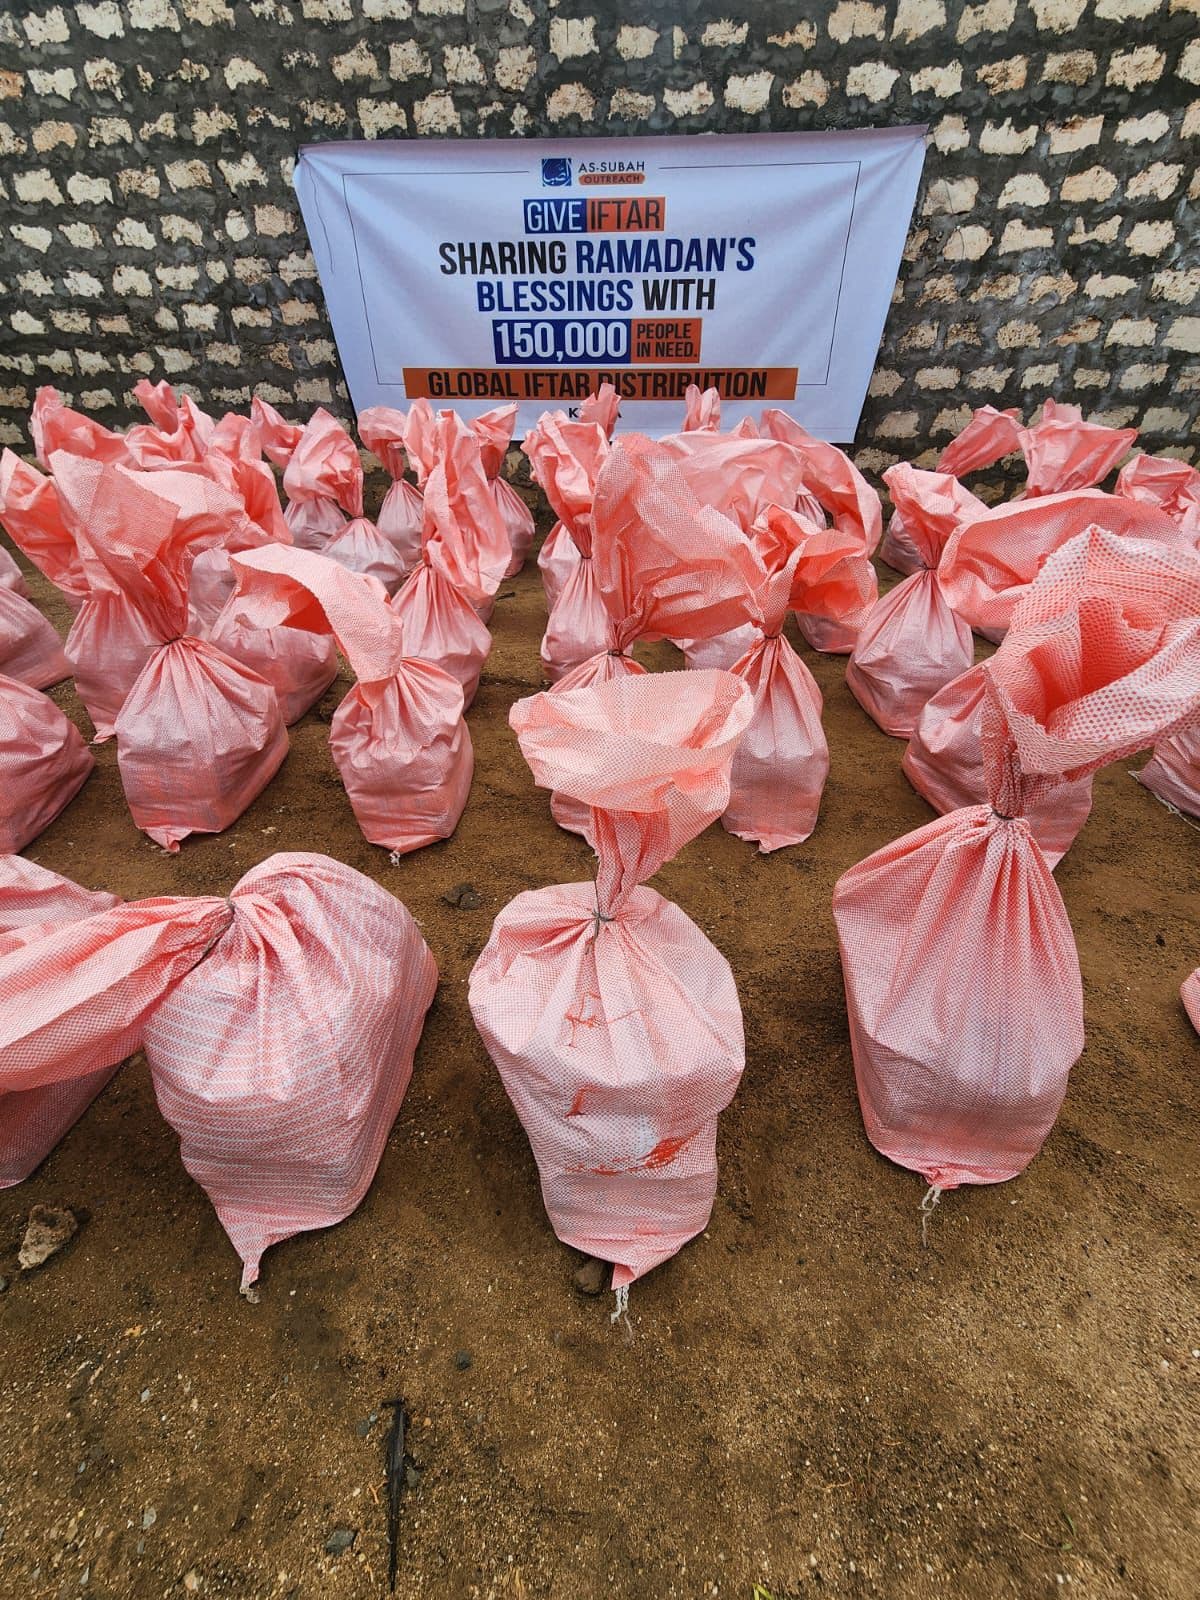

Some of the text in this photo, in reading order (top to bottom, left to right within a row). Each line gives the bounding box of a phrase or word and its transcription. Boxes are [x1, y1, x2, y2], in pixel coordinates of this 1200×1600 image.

[578, 161, 645, 173] AS-SUBAH
[583, 175, 640, 184] OUTREACH
[527, 200, 660, 231] GIVE IFTAR
[439, 237, 756, 275] SHARING RAMADAN'S
[477, 278, 716, 312] BLESSINGS WITH
[496, 321, 627, 362] 150,000
[636, 322, 691, 340] PEOPLE
[636, 341, 698, 358] IN NEED.
[428, 371, 518, 397] GLOBAL
[525, 372, 590, 397] IFTAR
